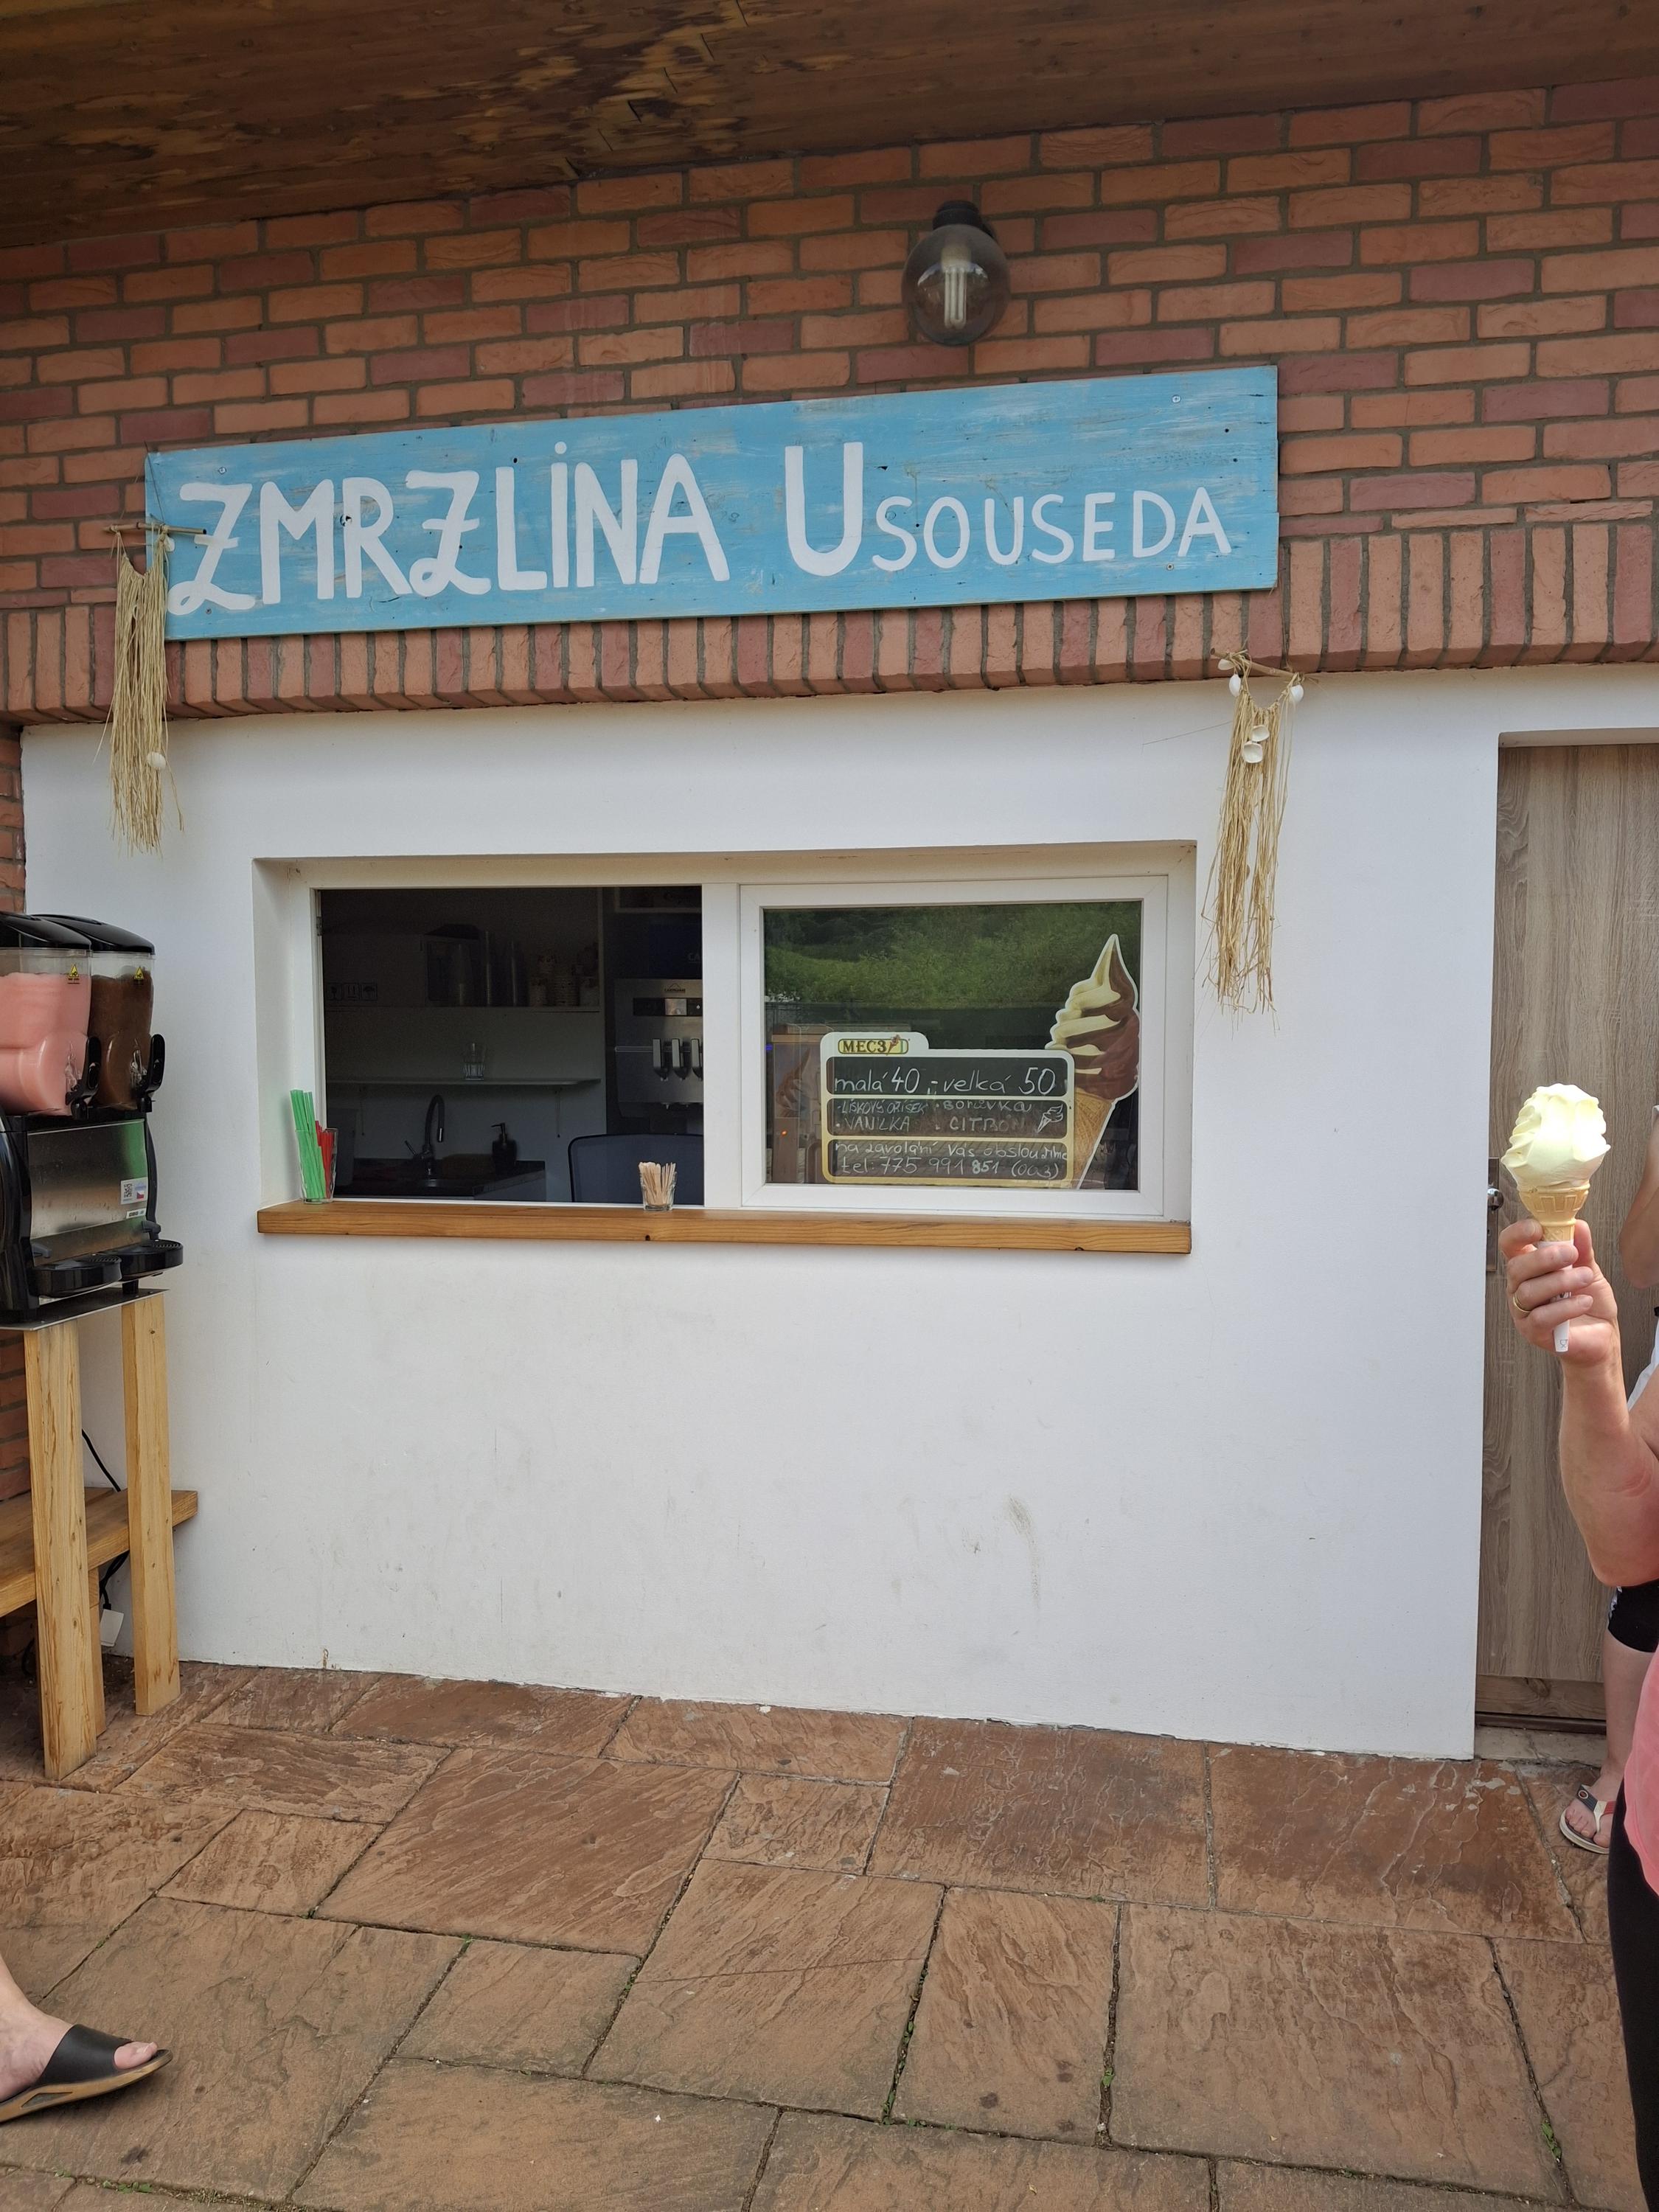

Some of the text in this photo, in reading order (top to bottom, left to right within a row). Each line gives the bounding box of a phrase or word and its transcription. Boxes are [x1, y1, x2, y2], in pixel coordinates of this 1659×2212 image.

[842, 1040, 888, 1054] MEC3
[879, 1155, 922, 1175] 775
[928, 1157, 964, 1175] 991
[971, 1159, 1001, 1175] 851
